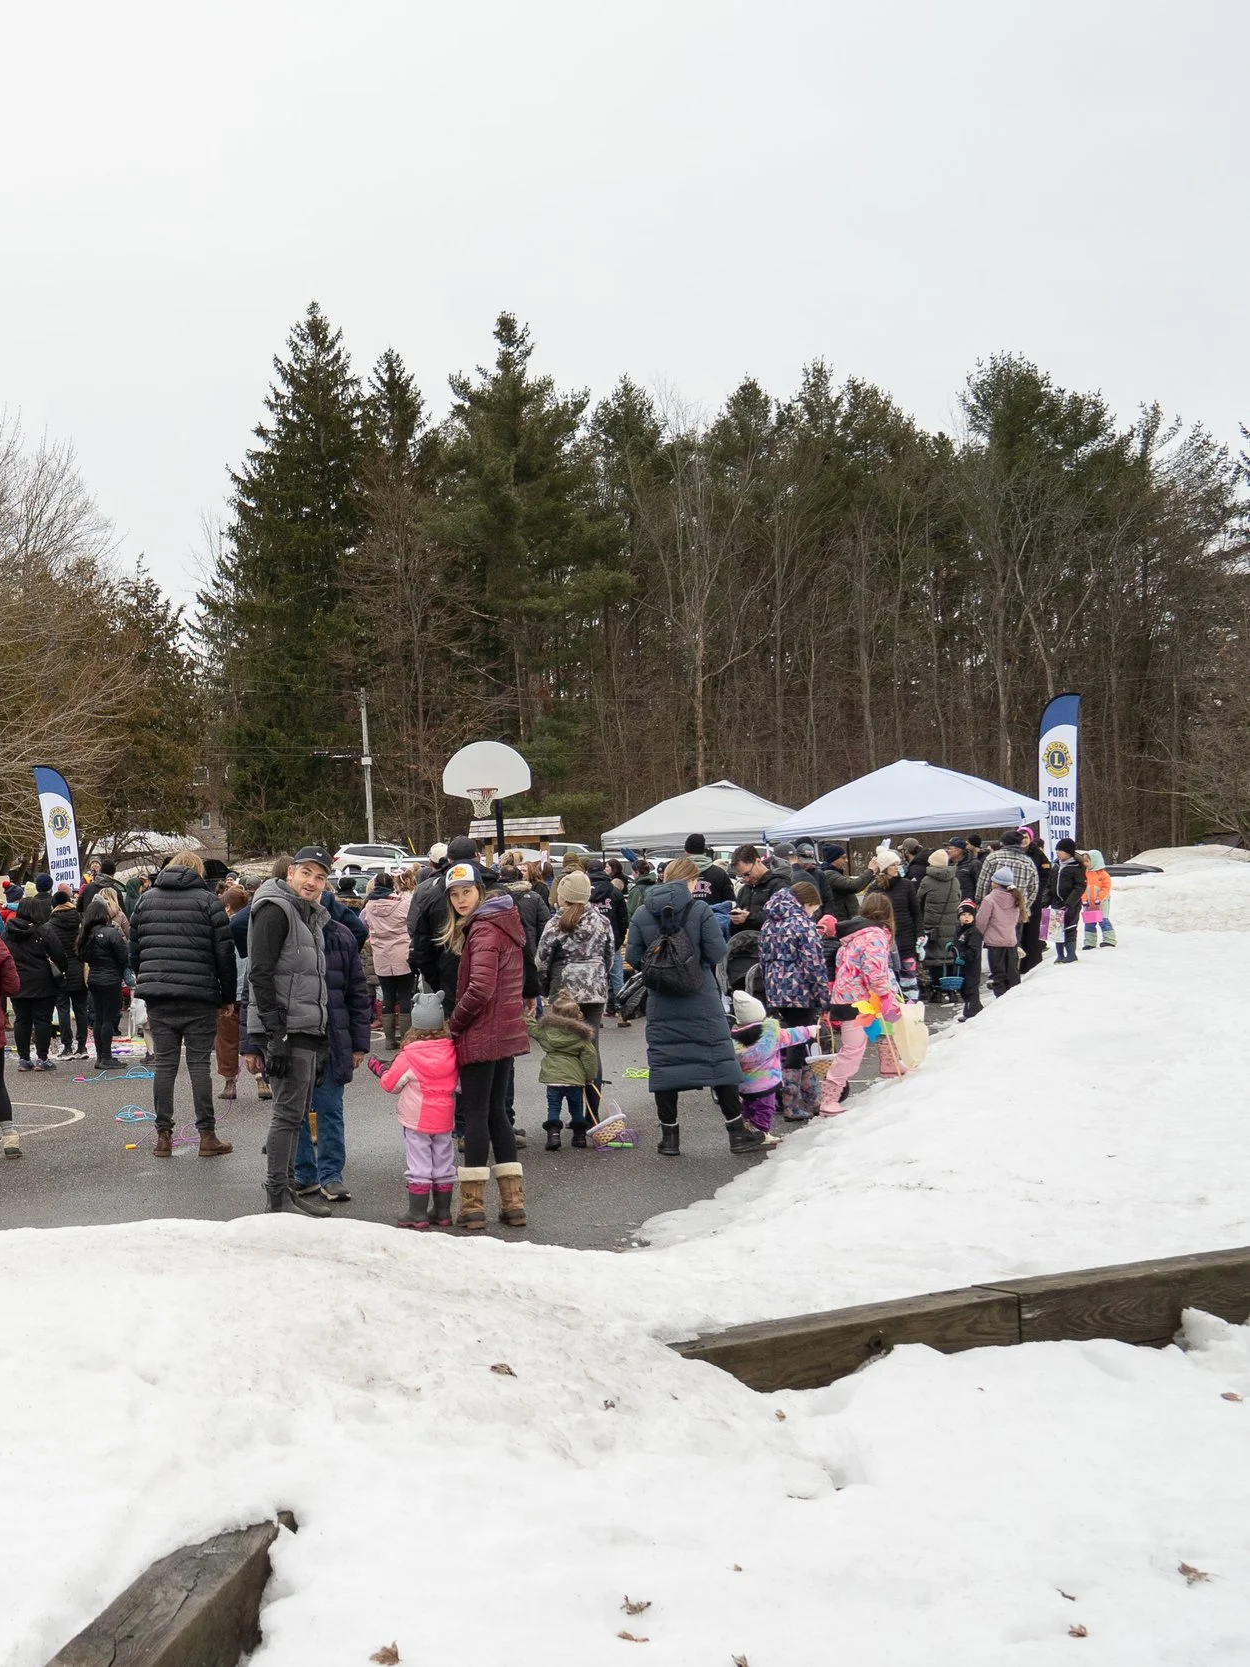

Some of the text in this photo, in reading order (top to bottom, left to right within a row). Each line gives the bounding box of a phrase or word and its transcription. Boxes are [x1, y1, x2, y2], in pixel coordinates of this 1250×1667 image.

[1054, 752, 1062, 766] L
[1047, 786, 1069, 798] PORT
[1043, 800, 1075, 812] ARLING
[1050, 815, 1071, 826] IONS
